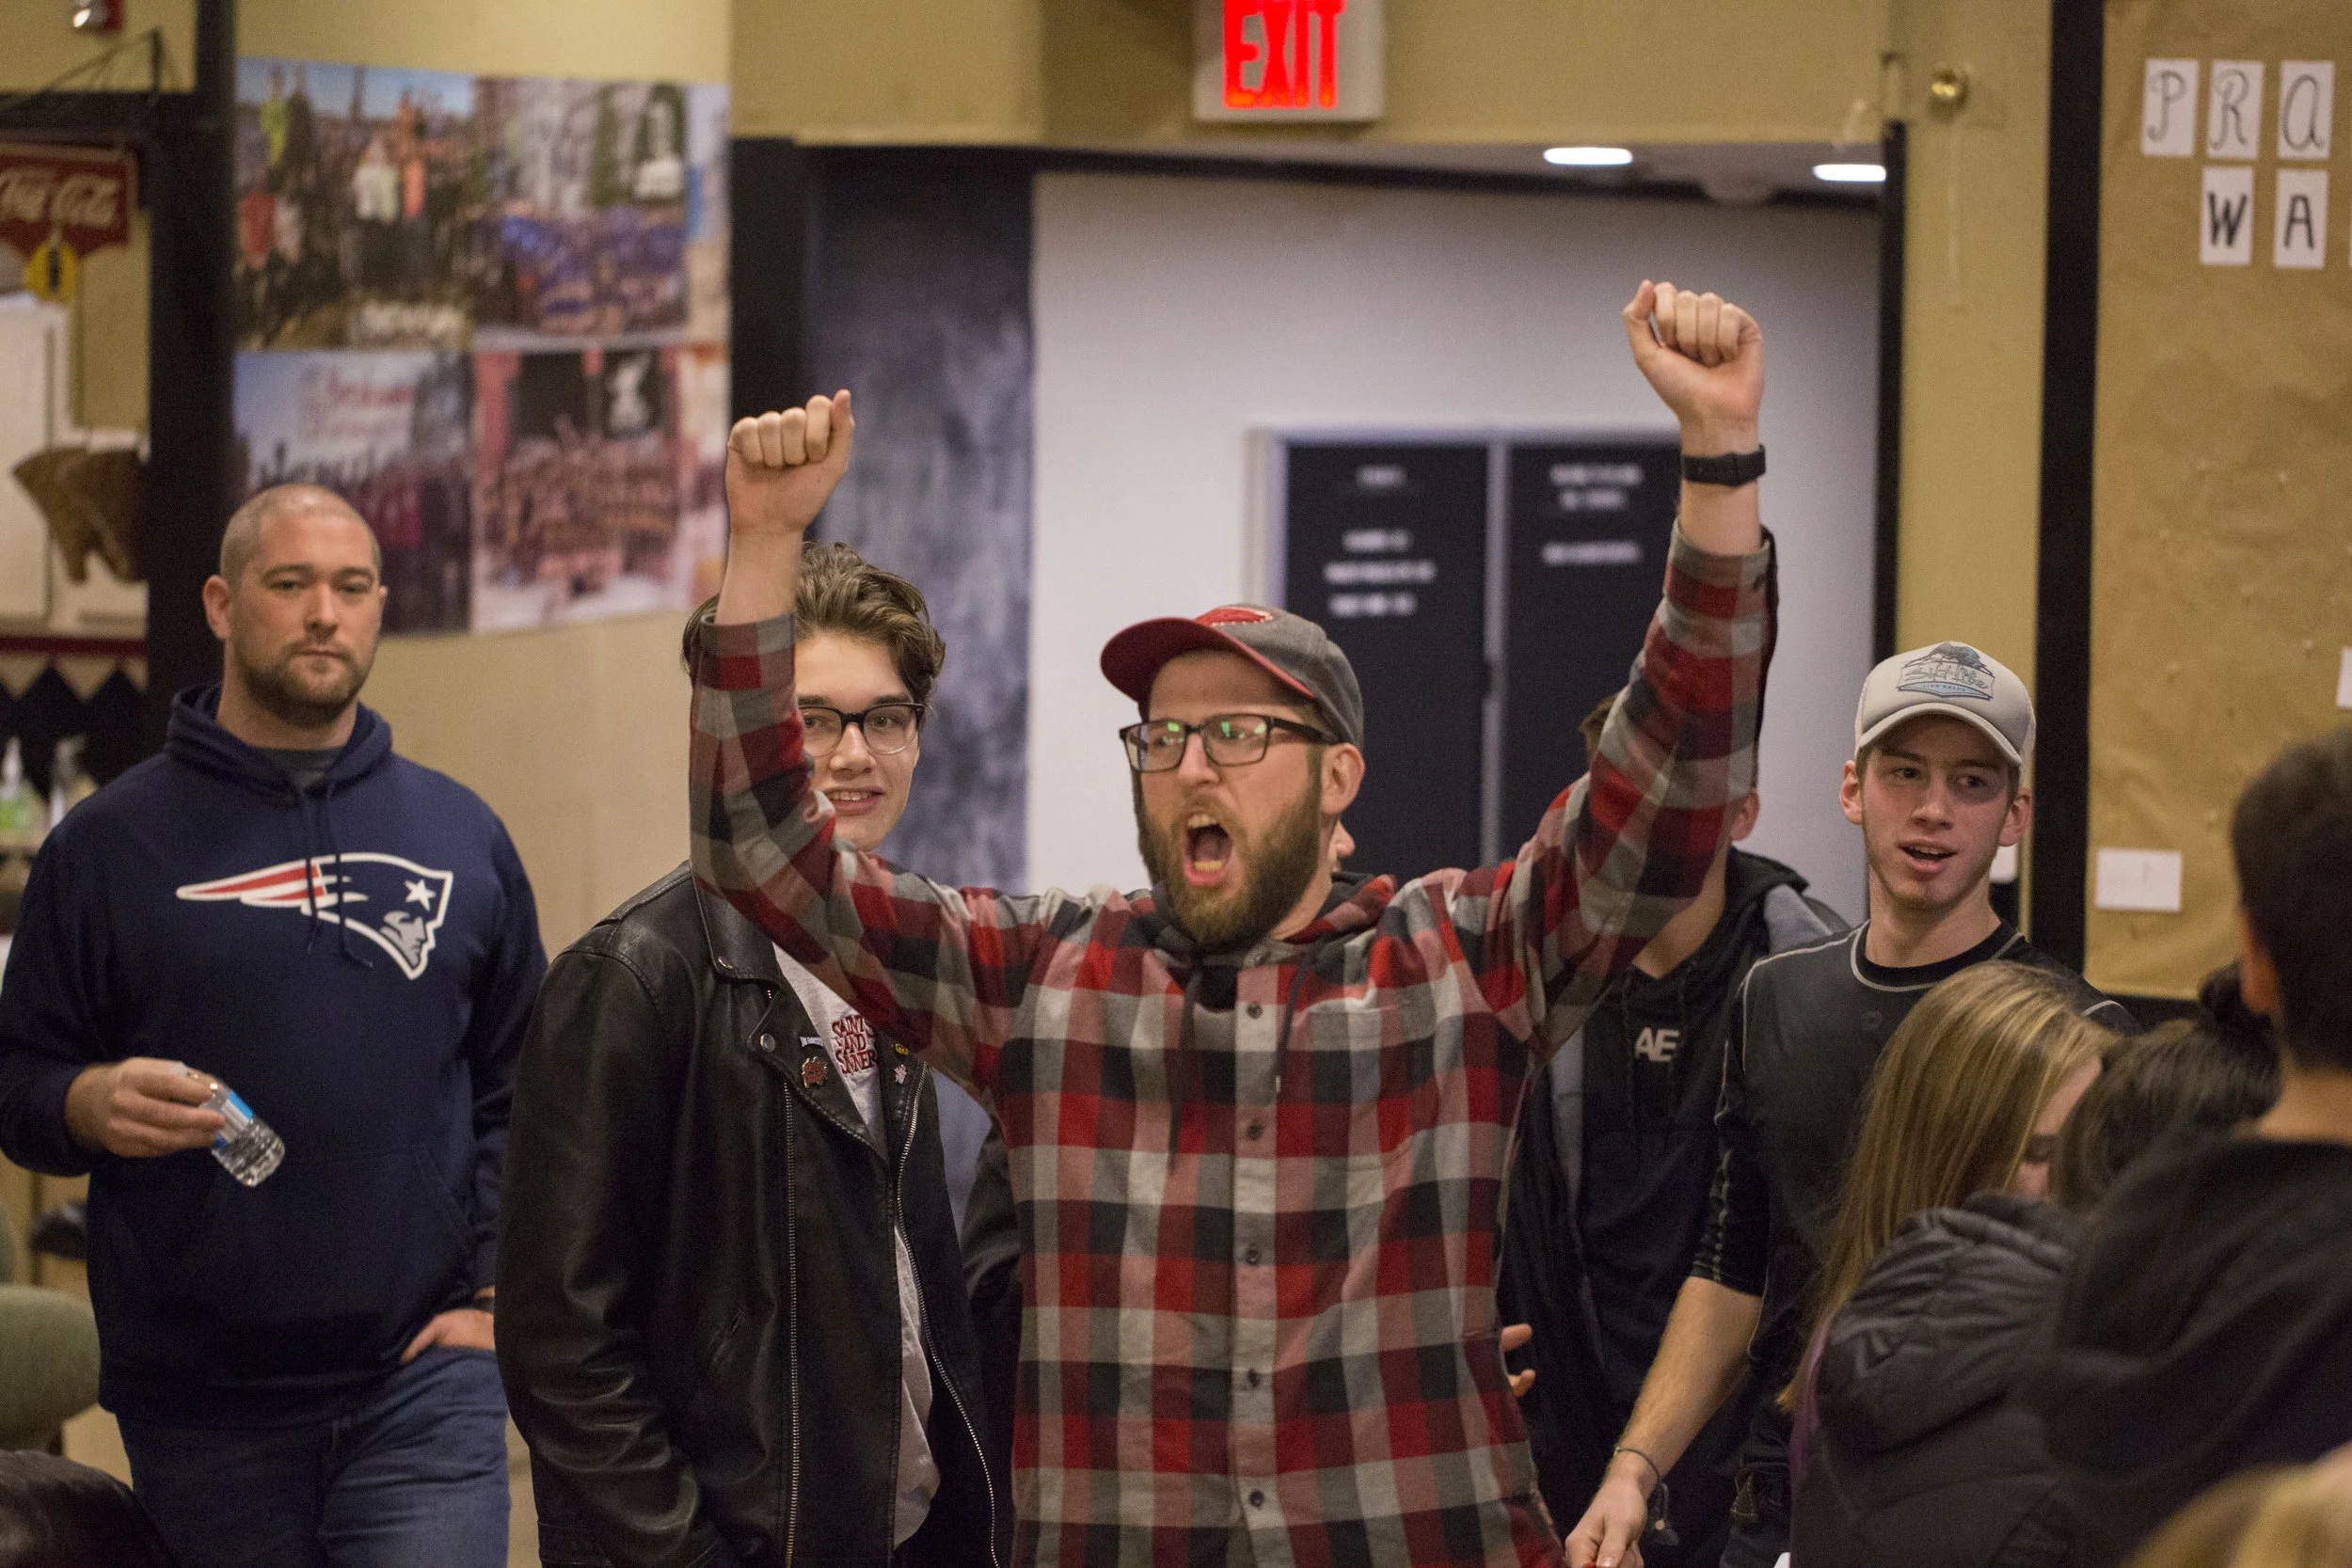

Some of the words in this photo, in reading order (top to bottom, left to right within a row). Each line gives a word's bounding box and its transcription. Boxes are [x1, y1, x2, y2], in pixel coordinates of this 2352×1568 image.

[1223, 0, 1346, 109] EXIT
[2207, 191, 2313, 249] WA
[837, 1033, 866, 1054] AND
[1635, 1026, 1679, 1062] AE
